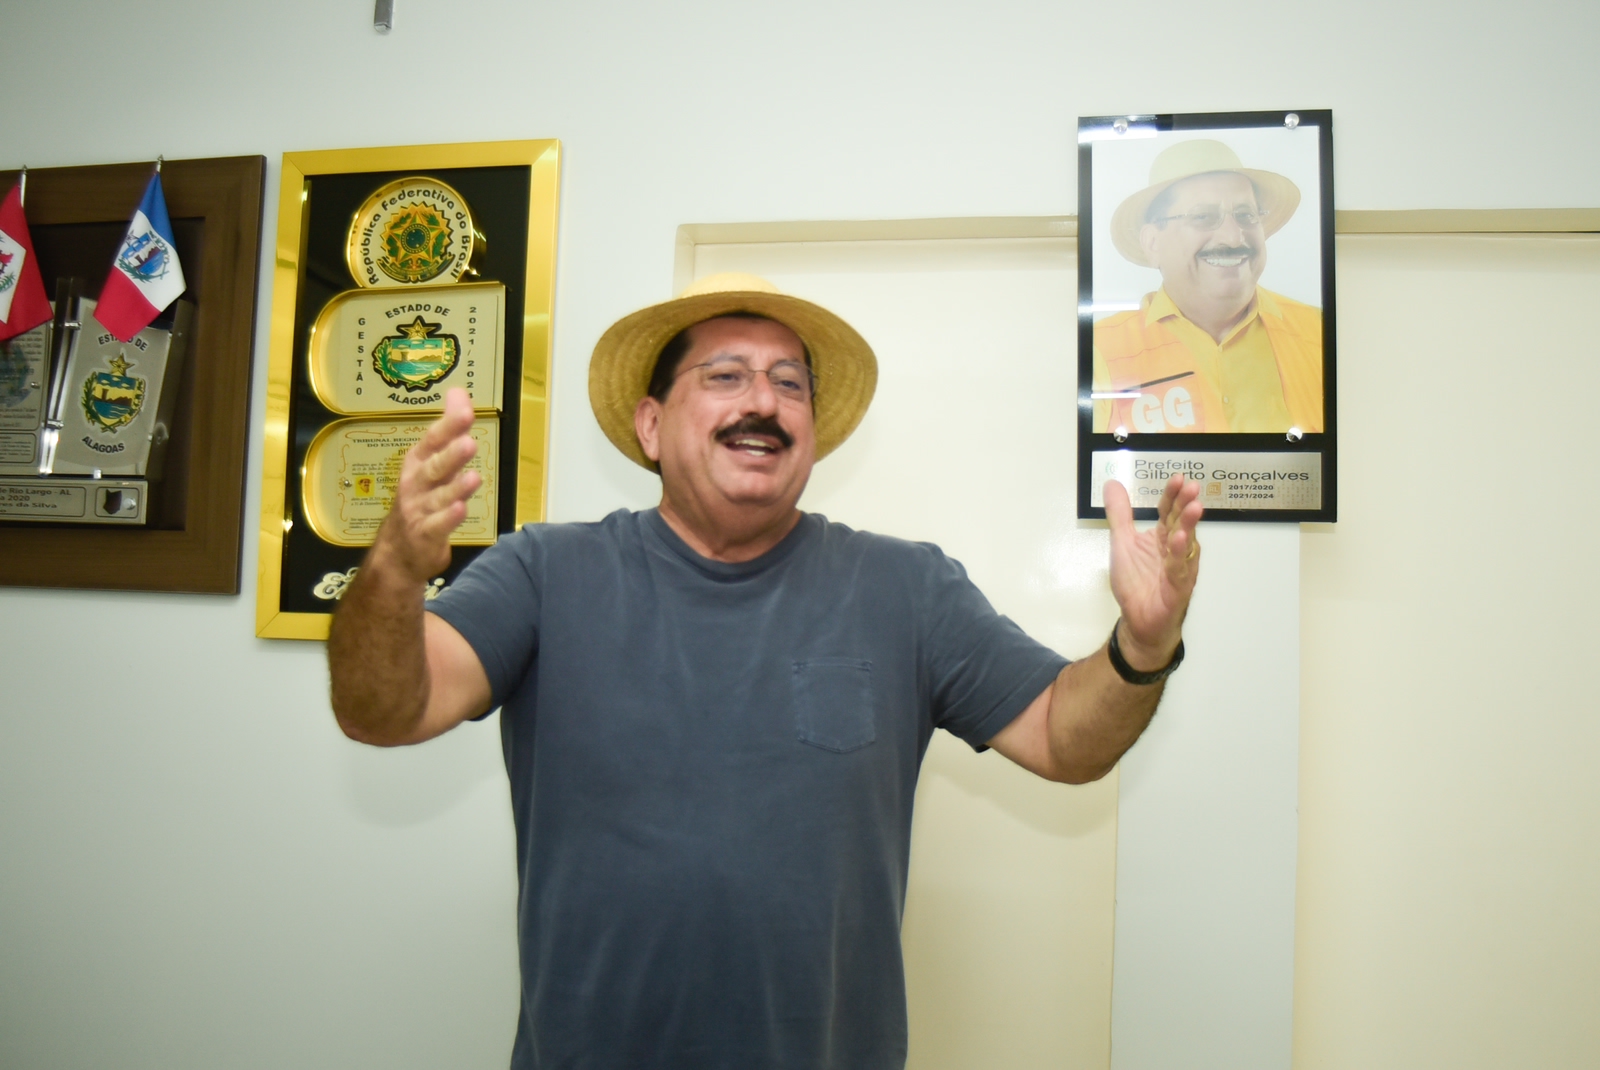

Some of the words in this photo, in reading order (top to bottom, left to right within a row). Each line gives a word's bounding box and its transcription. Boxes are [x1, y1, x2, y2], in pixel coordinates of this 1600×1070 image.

[381, 189, 455, 211] Federativa
[455, 211, 467, 229] do
[360, 213, 382, 285] República
[450, 235, 471, 279] Brasil
[385, 303, 431, 319] ESTADO
[434, 304, 451, 317] DE
[98, 333, 134, 345] ESTO
[135, 337, 148, 351] DE
[356, 317, 366, 396] GESTÃO
[388, 392, 442, 405] ALAGOAS
[1131, 386, 1196, 433] GG
[82, 435, 125, 454] ALAGOAS
[1135, 459, 1204, 470] Prefeito
[1212, 469, 1309, 482] Gonçalves
[26, 488, 52, 496] Largo
